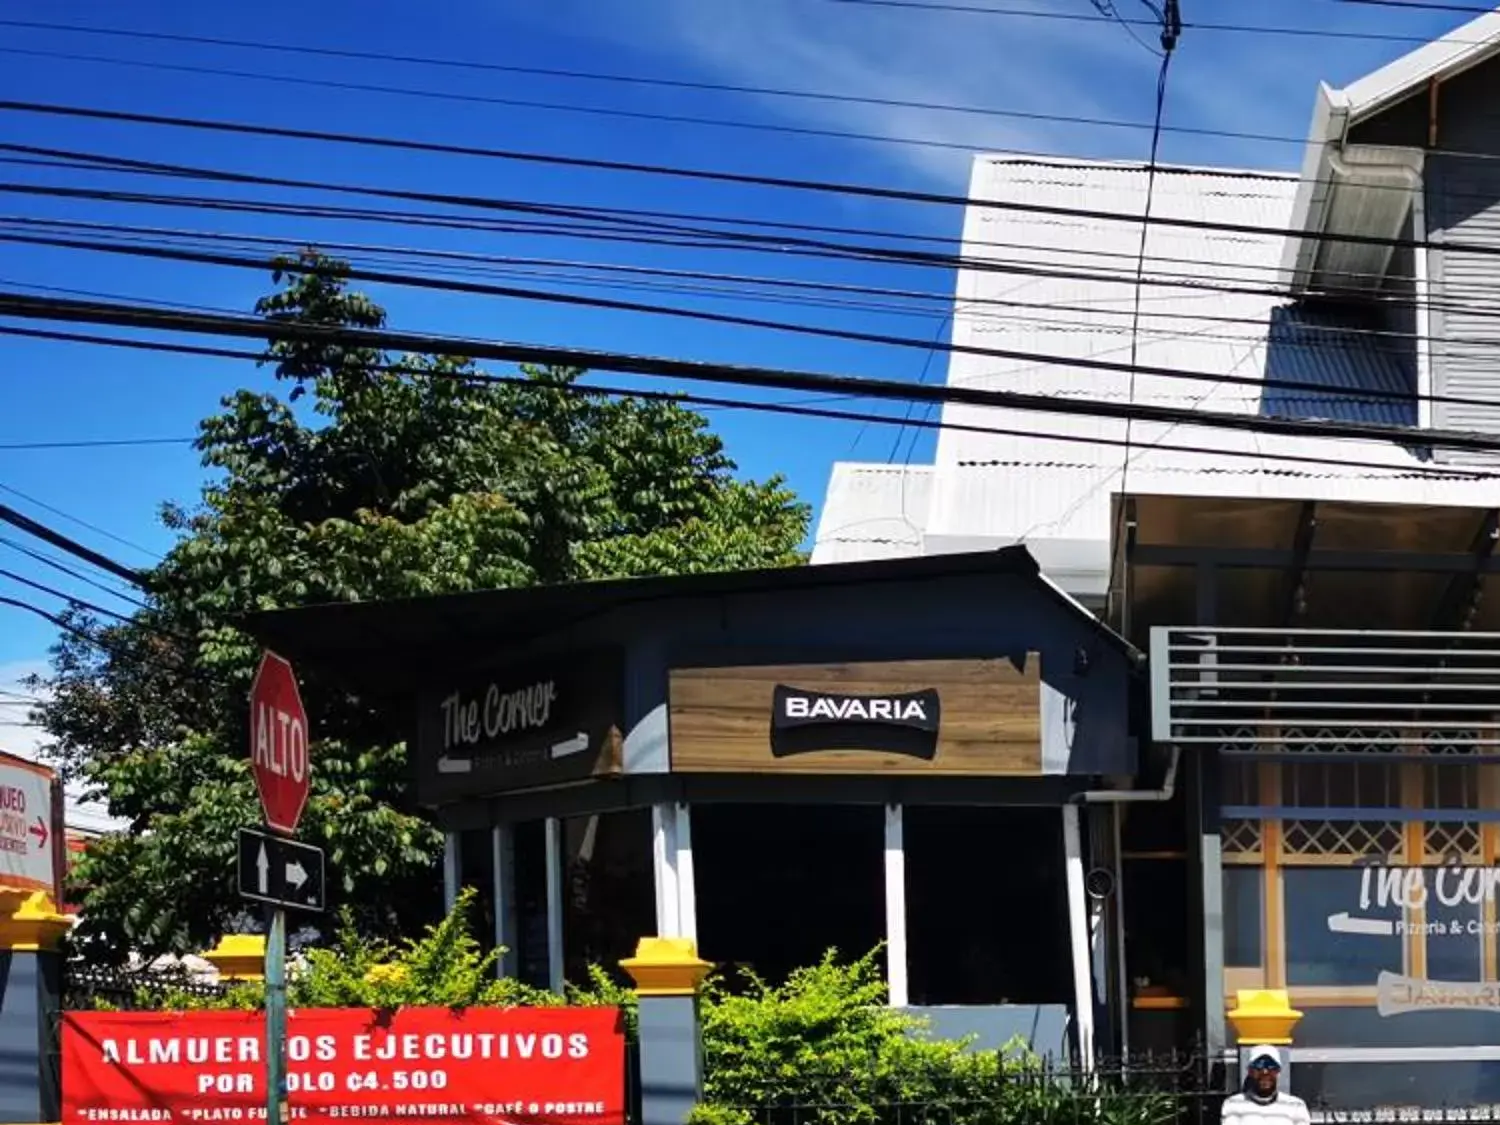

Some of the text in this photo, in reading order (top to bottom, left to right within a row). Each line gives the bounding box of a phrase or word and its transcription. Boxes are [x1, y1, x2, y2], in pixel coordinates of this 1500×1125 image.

[441, 680, 558, 749] The Corner
[785, 696, 927, 720] BAVARIA
[256, 702, 305, 783] ALTO
[1353, 853, 1428, 910] The
[1449, 920, 1464, 934] &
[102, 1033, 589, 1064] ALMUEROS EJECUTIVOS
[198, 1073, 253, 1093] POR
[287, 1071, 335, 1092] OLO
[248, 1106, 307, 1120] FUTE
[396, 1102, 467, 1116] NATURAL
[529, 1102, 540, 1114] O
[545, 1101, 605, 1115] POSTRE
